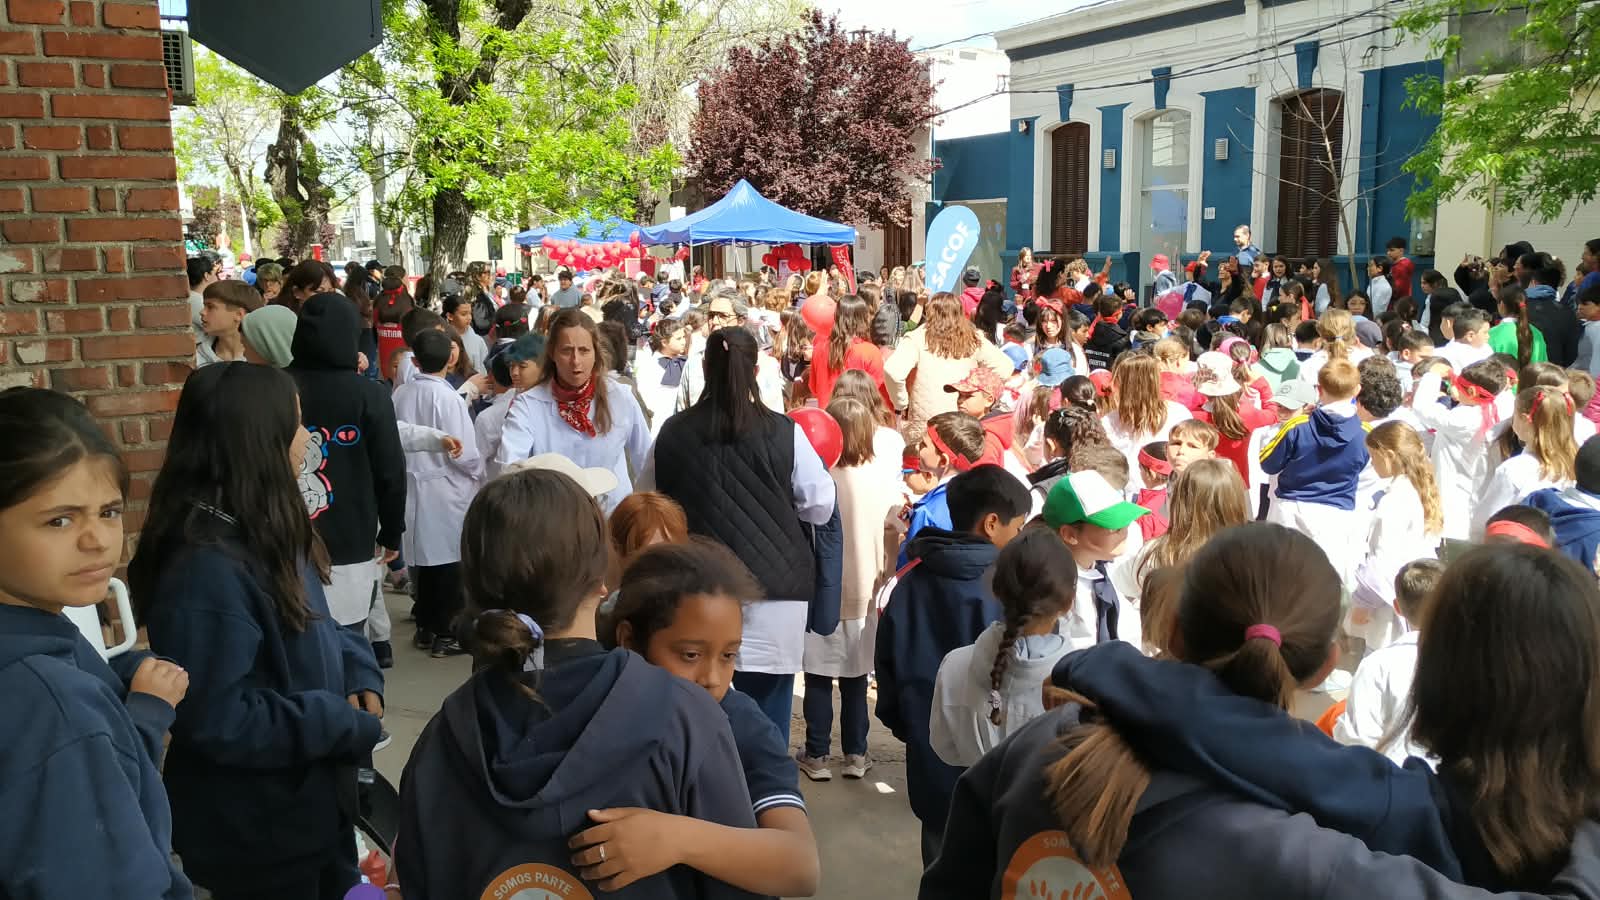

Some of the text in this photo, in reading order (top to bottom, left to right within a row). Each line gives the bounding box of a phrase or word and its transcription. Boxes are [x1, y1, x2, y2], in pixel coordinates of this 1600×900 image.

[932, 221, 969, 288] SACOF
[1042, 838, 1070, 849] SOM
[494, 872, 573, 900] SOMOS PARTE
